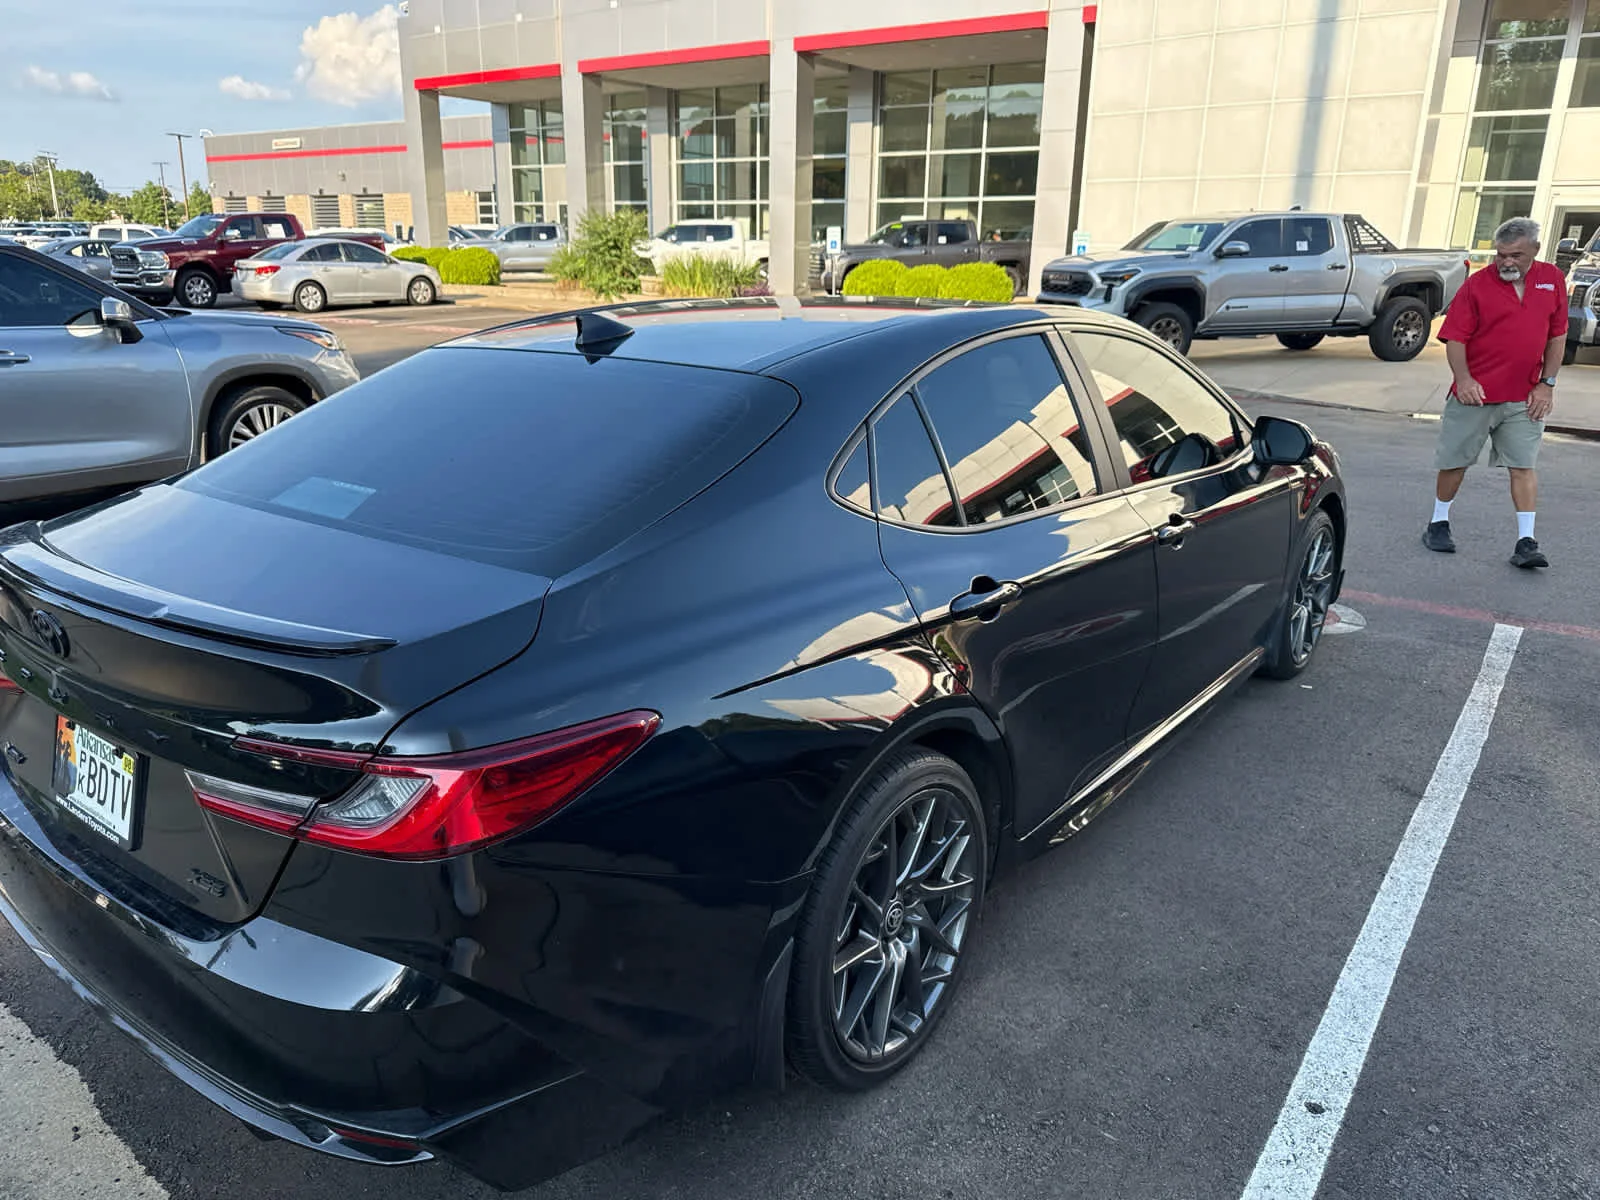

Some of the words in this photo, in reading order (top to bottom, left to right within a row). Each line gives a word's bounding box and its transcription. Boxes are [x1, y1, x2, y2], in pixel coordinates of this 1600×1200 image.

[76, 726, 116, 766] Arkansas
[86, 756, 131, 821] BDTV
[56, 795, 120, 844] www.LandersToyota.com
